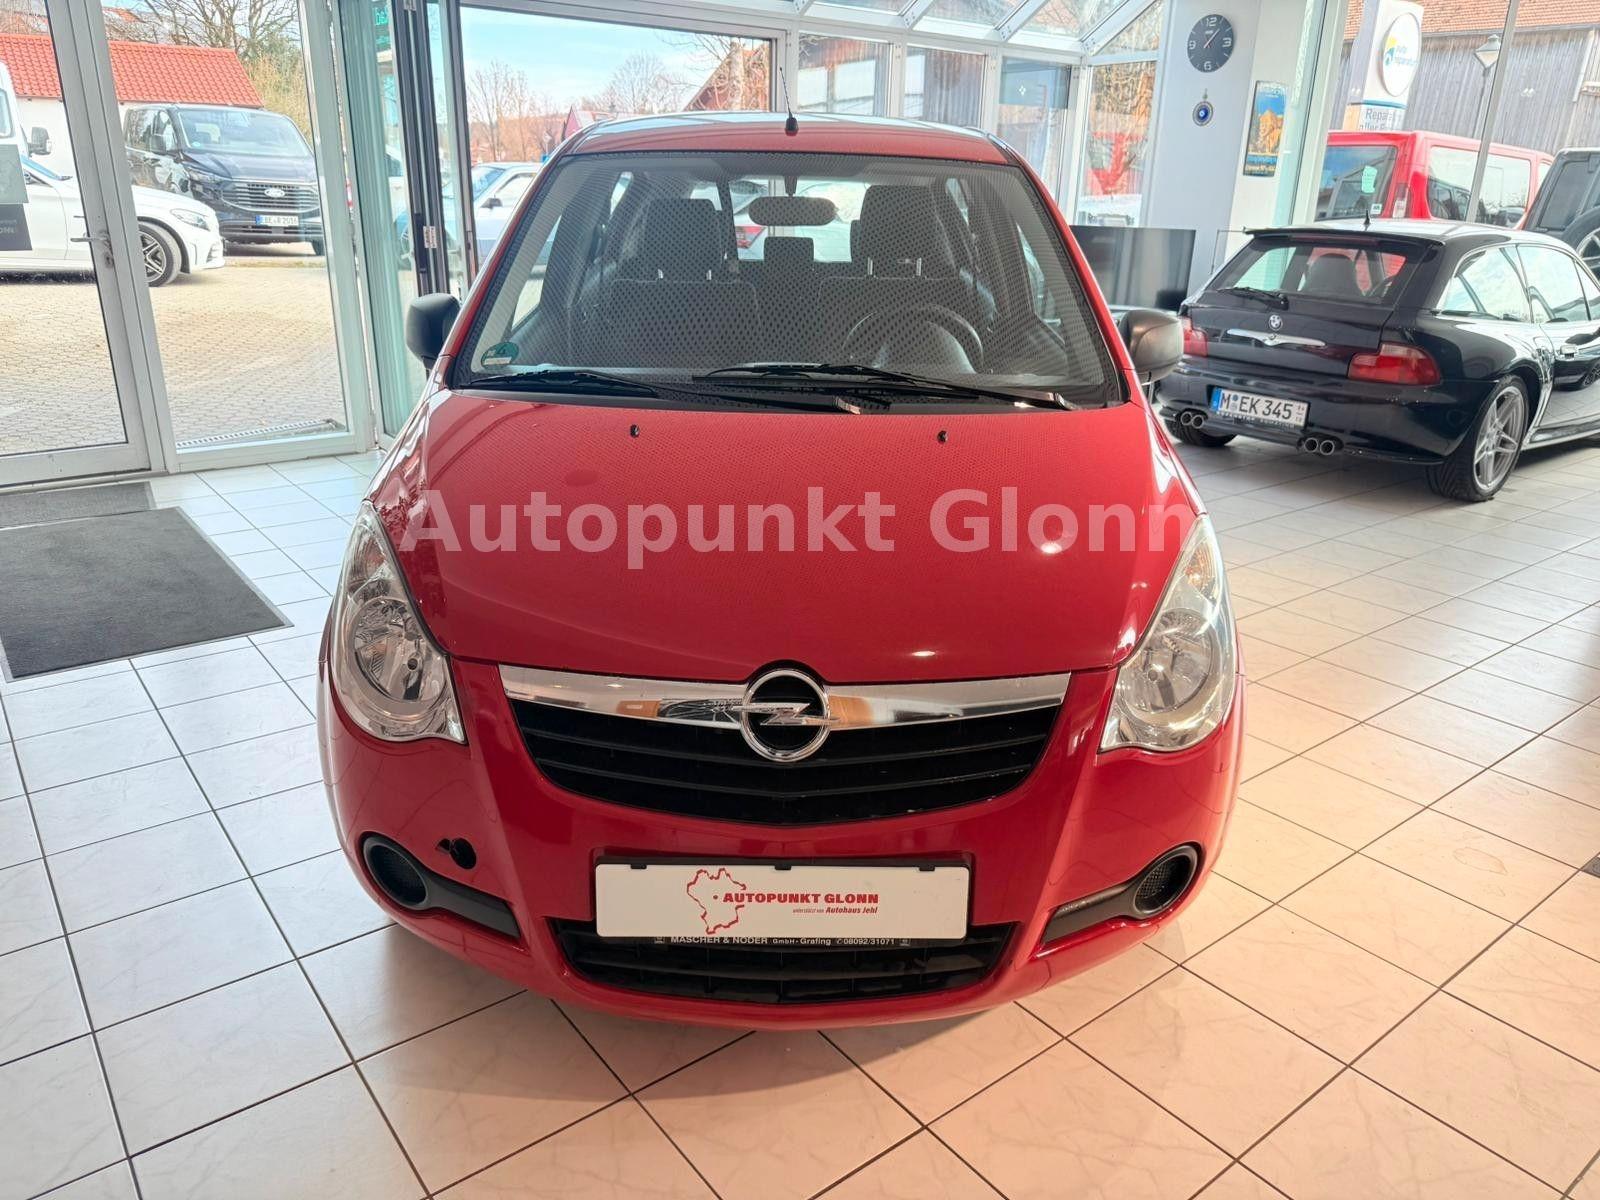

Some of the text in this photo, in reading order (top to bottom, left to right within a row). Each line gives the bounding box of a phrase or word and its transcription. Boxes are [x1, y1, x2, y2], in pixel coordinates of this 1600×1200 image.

[1206, 17, 1218, 27] 12
[1188, 40, 1197, 50] 9
[1222, 37, 1233, 48] 3
[1203, 61, 1212, 71] 6
[1220, 393, 1294, 420] M EK 345
[723, 893, 879, 904] AUTOPUNKT GLONN
[825, 906, 861, 914] Autohaus
[862, 906, 878, 915] Jehl
[670, 936, 720, 944] MASCHER
[800, 937, 831, 946] Grafing
